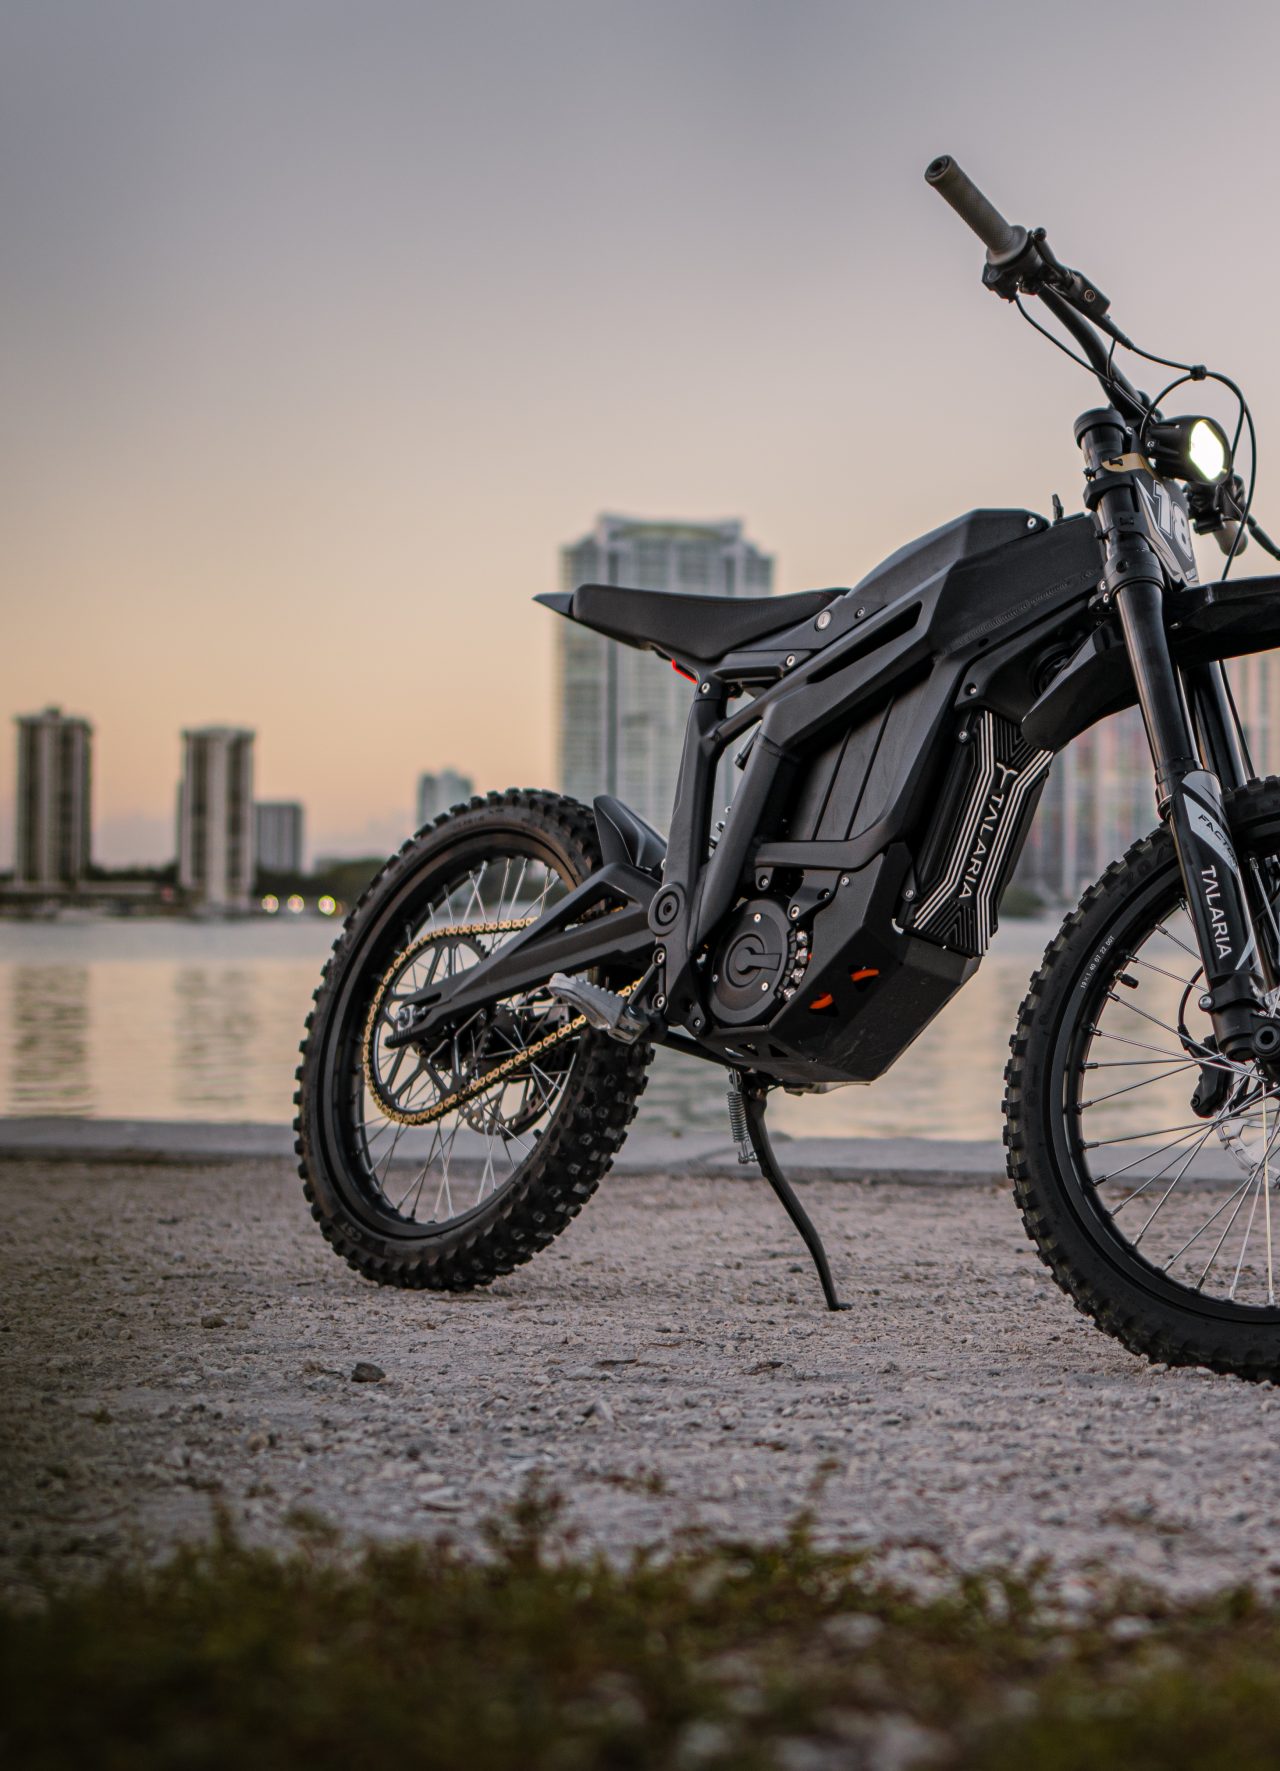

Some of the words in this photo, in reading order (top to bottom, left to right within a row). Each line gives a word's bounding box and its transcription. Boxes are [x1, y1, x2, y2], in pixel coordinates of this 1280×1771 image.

[1153, 479, 1193, 562] 18
[958, 794, 1005, 900] TALARIA
[1201, 865, 1233, 960] TALARIA
